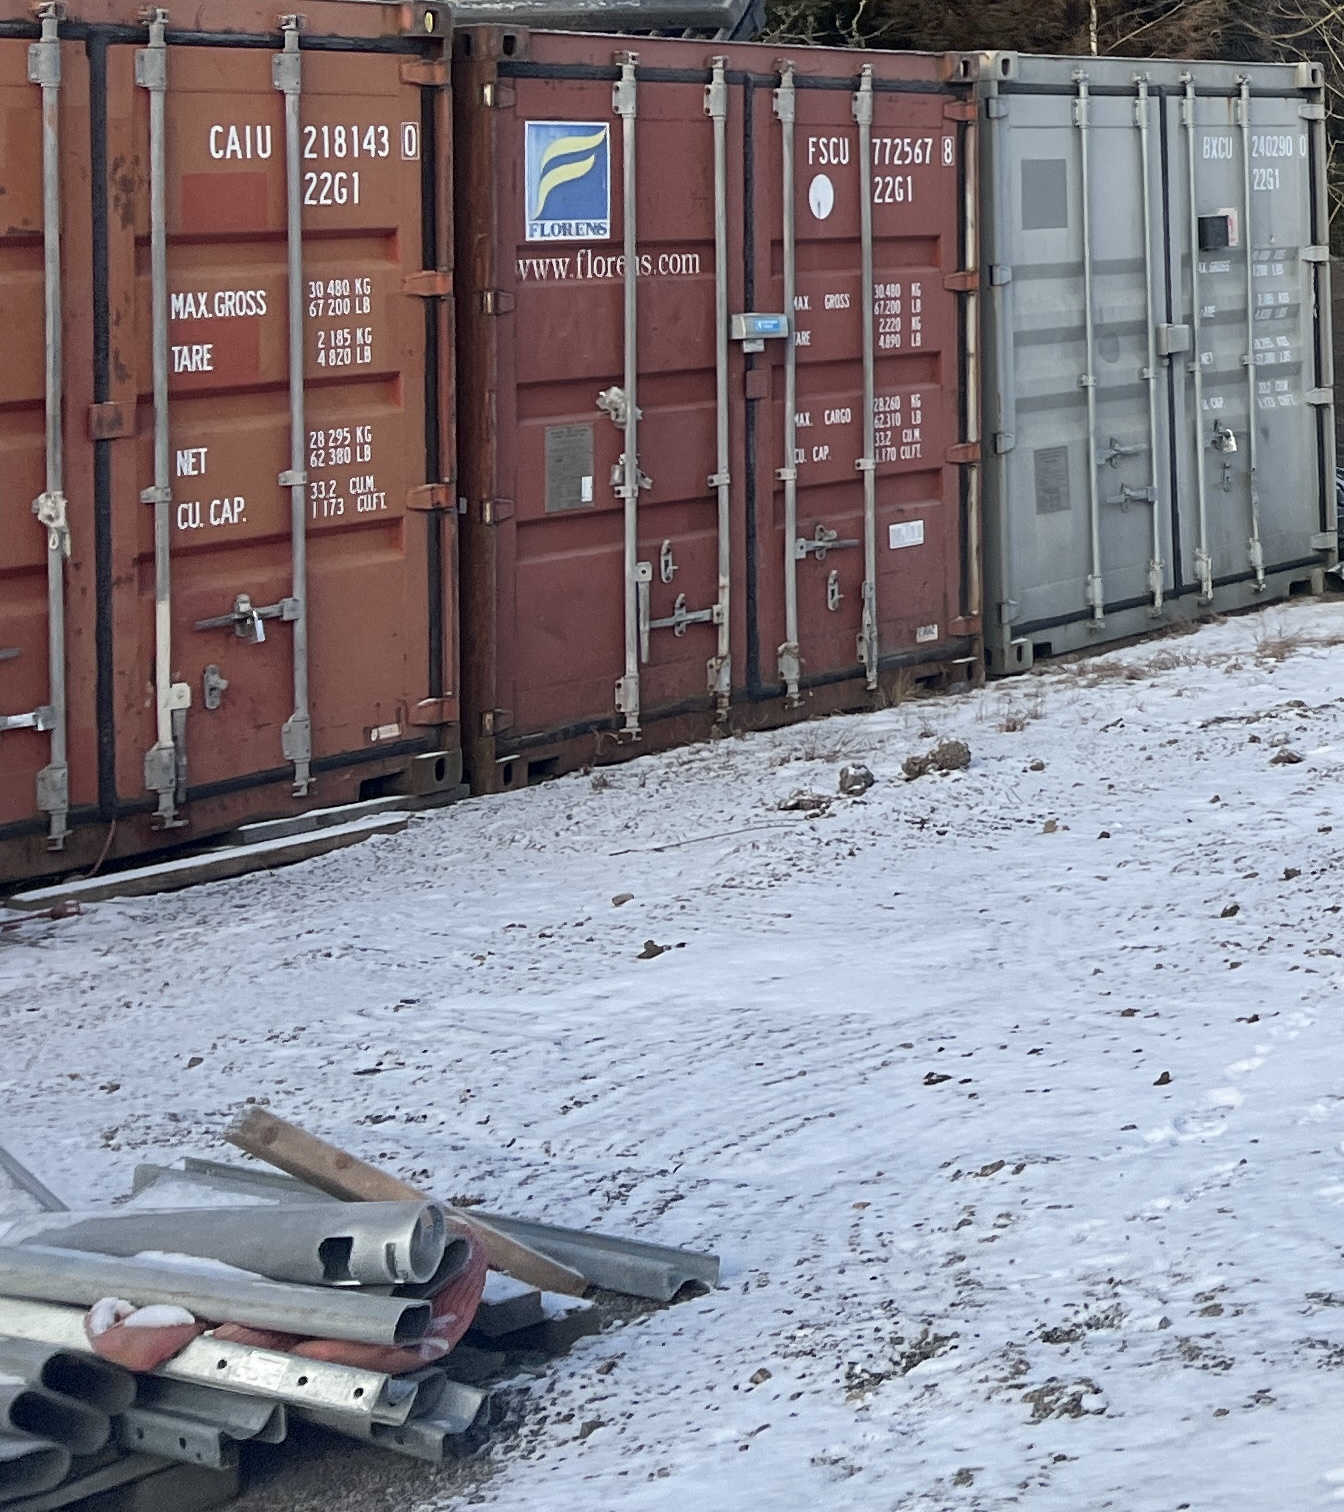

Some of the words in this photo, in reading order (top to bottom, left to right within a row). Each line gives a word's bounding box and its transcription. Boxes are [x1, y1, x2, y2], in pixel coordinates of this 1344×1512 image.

[210, 126, 271, 159] CAIU
[304, 126, 389, 158] 218143
[809, 137, 848, 164] FSCU
[872, 138, 932, 164] 772567
[1203, 136, 1234, 159] BXCU
[1252, 135, 1293, 157] 240290
[305, 172, 358, 204] 22G1
[874, 176, 912, 203] 22G1
[1253, 168, 1280, 191] 22G1
[528, 221, 608, 238] FLORENS
[309, 281, 323, 298] 30
[327, 280, 351, 297] 480
[355, 278, 370, 295] KG
[911, 282, 922, 297] KG
[309, 299, 324, 317] 67
[328, 296, 350, 315] 200
[356, 294, 370, 313] LB
[825, 294, 849, 309] GROSS
[911, 298, 922, 313] LB
[911, 315, 922, 331] KG
[318, 331, 325, 348] 2
[331, 329, 351, 347] 185
[357, 327, 372, 344] KG
[911, 331, 922, 347] LB
[172, 344, 213, 372] TARE
[317, 350, 325, 366] 4
[329, 348, 351, 365] 820
[357, 346, 371, 363] LB
[910, 393, 922, 408] KG
[825, 408, 851, 424] CARGO
[911, 409, 922, 425] LB
[310, 431, 324, 449] 28
[329, 428, 350, 448] 295
[356, 426, 371, 443] KG
[177, 448, 207, 476] NET
[311, 450, 326, 467] 62
[329, 447, 351, 465] 380
[357, 445, 371, 462] LB
[311, 480, 336, 499] 33.2
[178, 502, 204, 529] CU.
[210, 497, 246, 525] CAP.
[323, 499, 344, 516] 173
